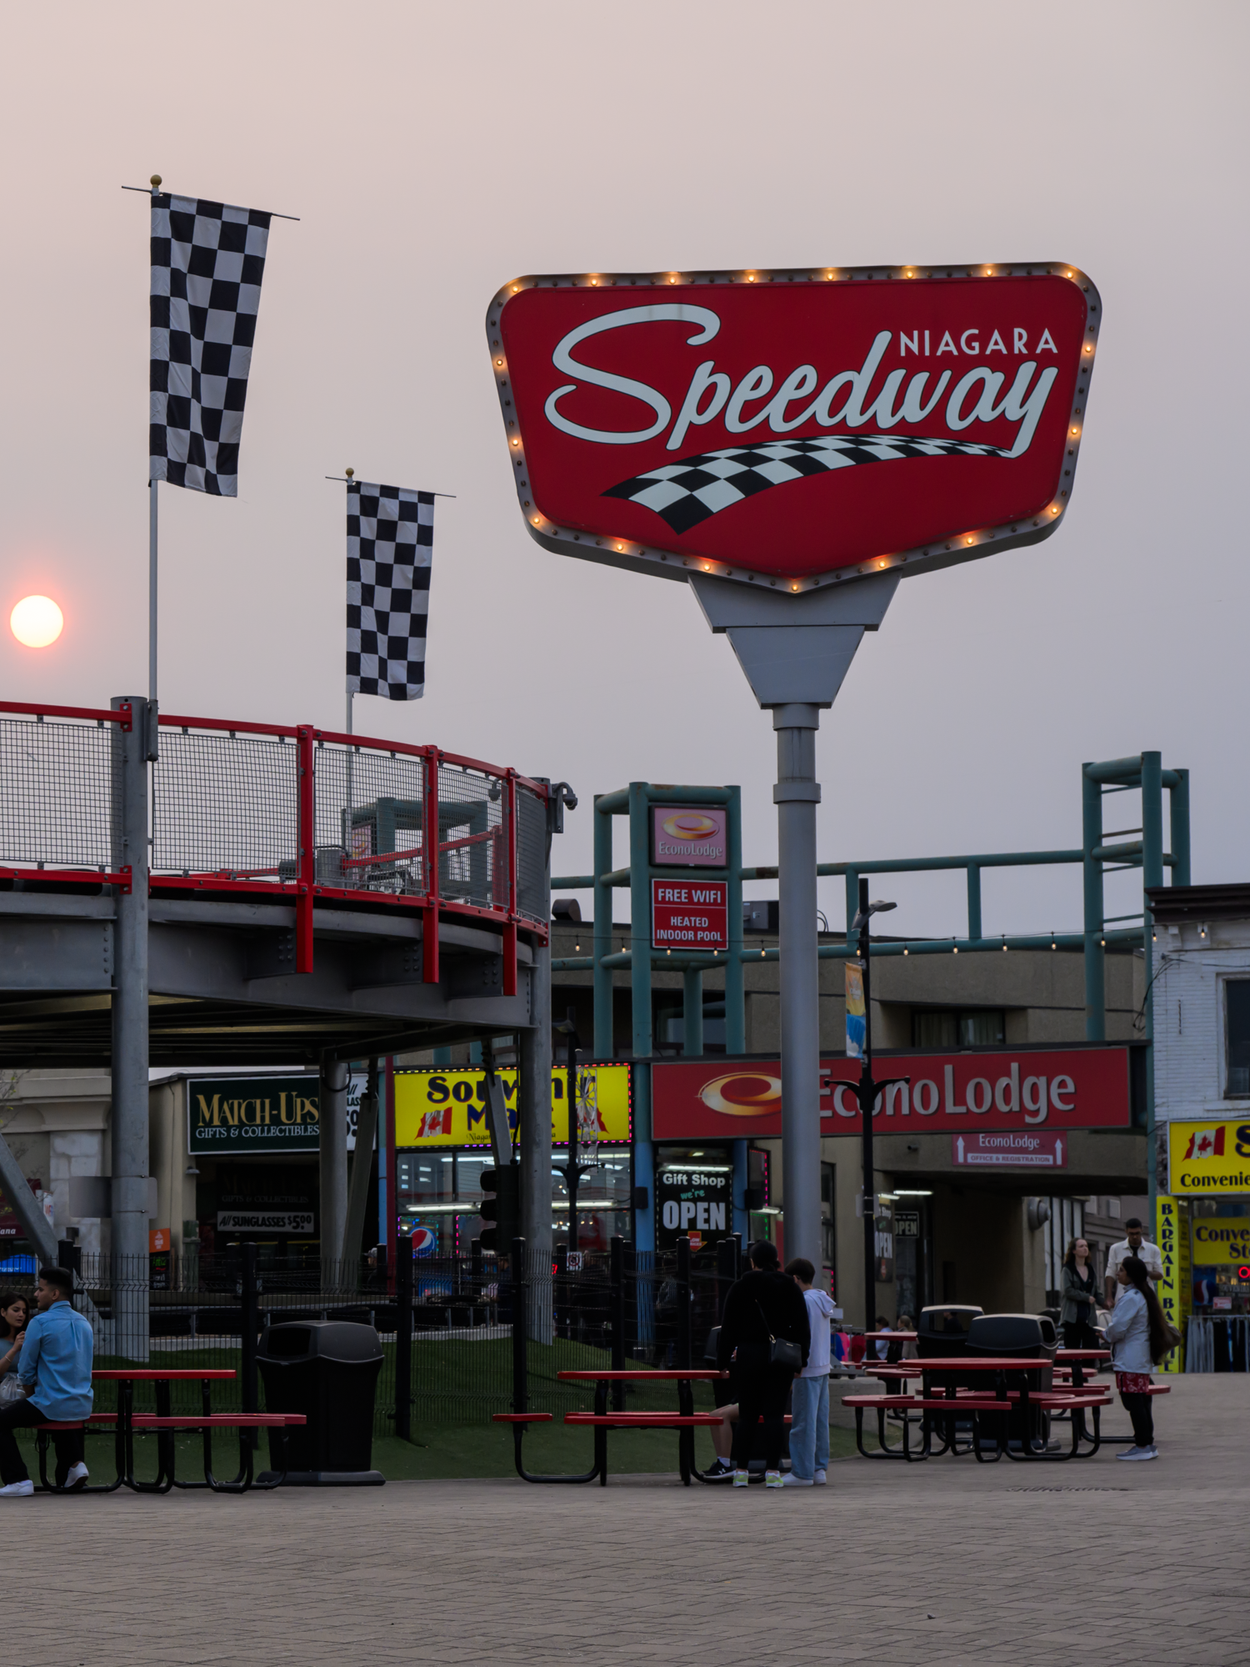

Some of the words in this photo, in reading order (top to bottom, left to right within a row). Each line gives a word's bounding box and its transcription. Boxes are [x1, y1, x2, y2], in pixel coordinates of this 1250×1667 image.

[899, 327, 1058, 357] NIAGARA
[544, 302, 1058, 459] Speedway
[658, 841, 723, 859] EconoLodge
[658, 888, 689, 902] FREE
[691, 889, 721, 904] WIFI
[670, 916, 709, 928] HEATED
[657, 929, 695, 941] INDOOR
[697, 930, 723, 942] POOL
[819, 1062, 1076, 1124] EcnoLodge
[195, 1091, 319, 1127] MATCH-UPS
[467, 1103, 555, 1131] Ma
[196, 1126, 228, 1139] GIFTS
[230, 1126, 239, 1138] &
[242, 1124, 320, 1138] COLLECTIBLES
[979, 1133, 1040, 1151] EconoLodge
[662, 1173, 688, 1186] Gift
[691, 1174, 726, 1189] Shop
[680, 1188, 706, 1200] we're
[232, 1215, 286, 1228] SUNGLASSES
[287, 1214, 312, 1230] $5.00
[662, 1200, 726, 1230] OPEN
[1196, 1225, 1250, 1242] Conve
[1161, 1203, 1174, 1290] BARGAIN
[1229, 1243, 1250, 1259] St
